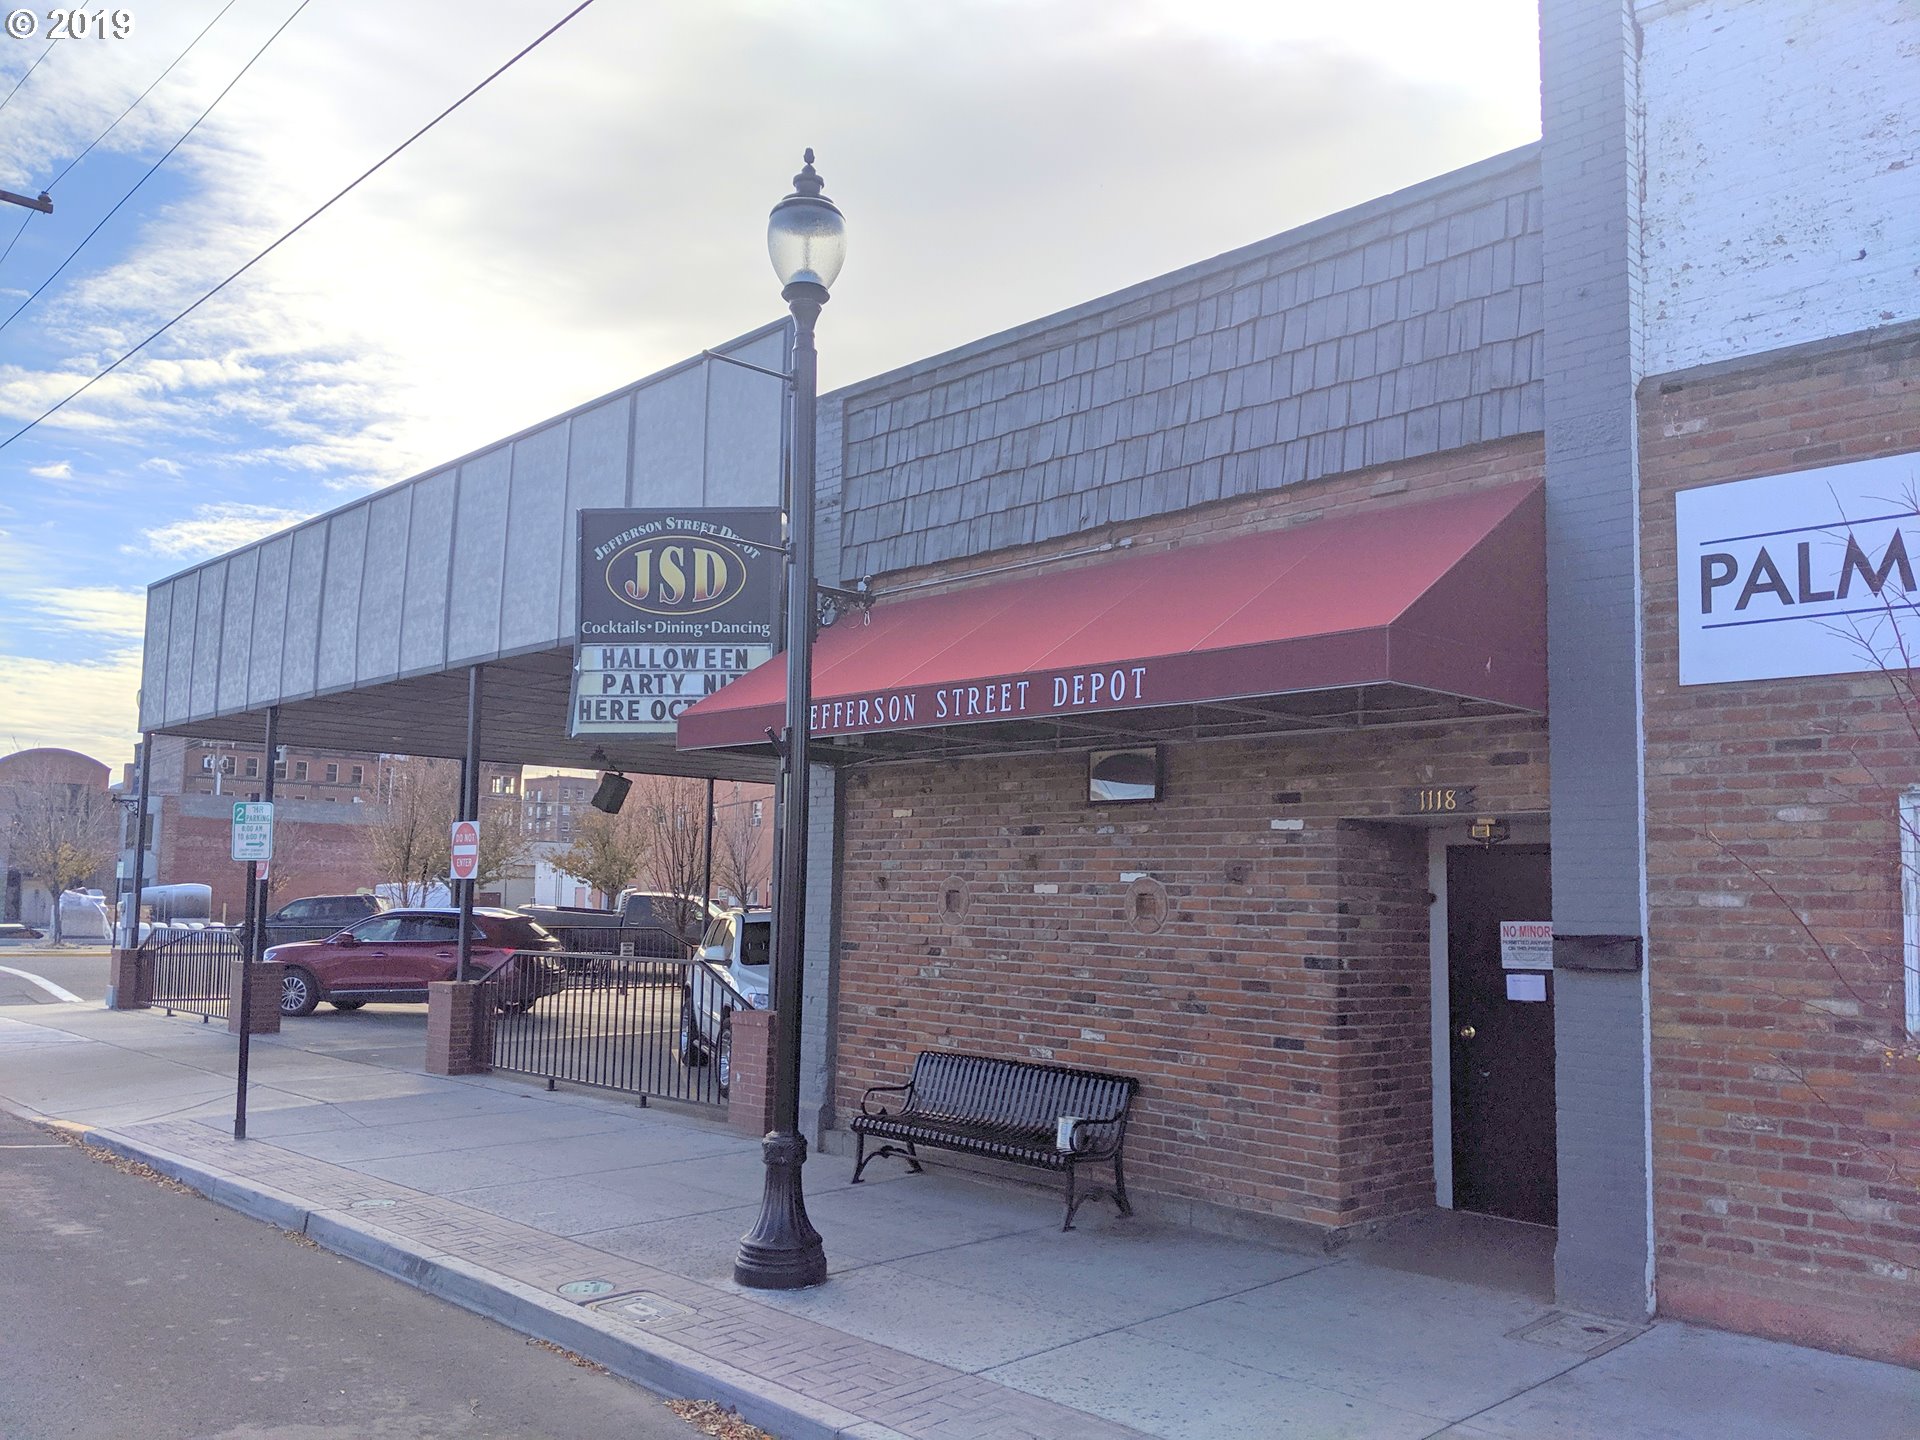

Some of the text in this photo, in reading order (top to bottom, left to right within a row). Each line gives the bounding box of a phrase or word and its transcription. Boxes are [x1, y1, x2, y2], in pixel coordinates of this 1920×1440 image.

[594, 517, 760, 560] JEFFERSON STREET DEOT
[624, 545, 728, 605] JSD
[1701, 527, 1917, 614] PALM
[581, 620, 771, 637] Cocktails Dining Dancing
[602, 648, 748, 669] HALLOWEEN
[602, 673, 686, 694] PARTY
[579, 699, 640, 720] HERE
[810, 667, 1146, 731] EFFERSON STREET DEPOT
[1420, 789, 1457, 811] 1118
[236, 807, 245, 821] 2
[246, 814, 270, 822] PARKING
[456, 832, 475, 842] DO NOT
[457, 858, 471, 867] ENTER
[1503, 926, 1553, 938] NO MINOR
